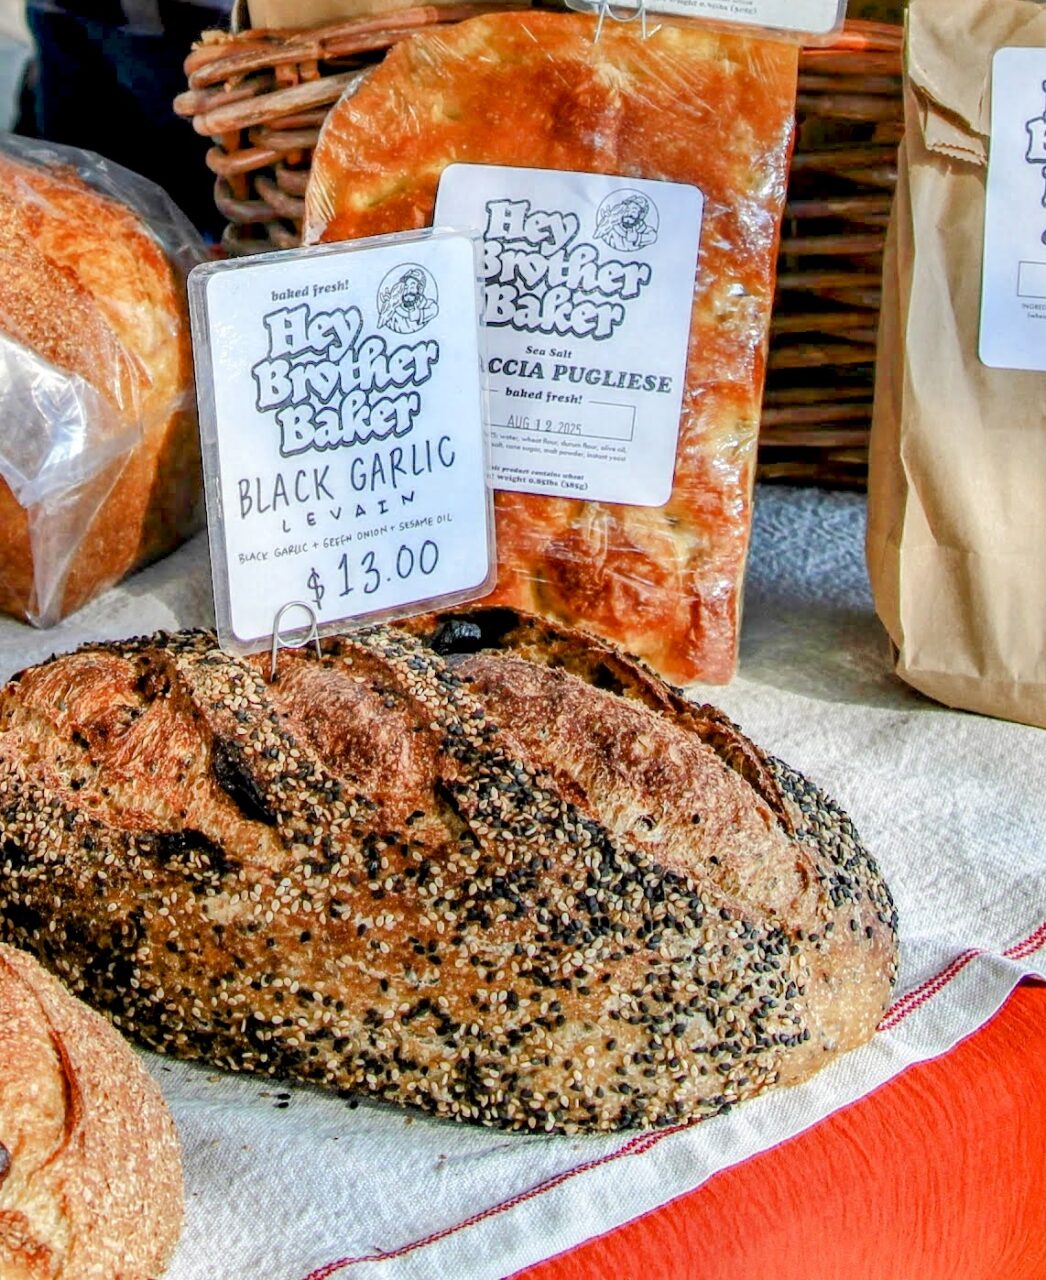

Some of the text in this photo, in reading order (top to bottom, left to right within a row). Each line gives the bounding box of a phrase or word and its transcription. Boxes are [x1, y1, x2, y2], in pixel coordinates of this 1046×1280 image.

[484, 199, 580, 252] Hey
[271, 280, 349, 302] baked fresh!
[484, 283, 626, 341] Baker
[264, 303, 363, 362] Hey
[525, 345, 573, 359] Sea Salt
[251, 335, 440, 412] Brother
[505, 387, 583, 404] baked fresh!
[552, 364, 673, 394] PUGLIESE
[276, 389, 421, 458] Baker
[507, 415, 529, 429] AUG
[559, 422, 581, 435] 2025
[238, 435, 456, 519] BLACK GARLIC
[497, 474, 526, 483] weight
[282, 491, 415, 533] LEVAIN
[238, 552, 268, 564] BLACK
[274, 543, 308, 558] GARLIC
[323, 535, 352, 549] GREEN
[357, 526, 388, 541] ONION
[399, 516, 433, 531] SESAME
[437, 512, 453, 524] OIL
